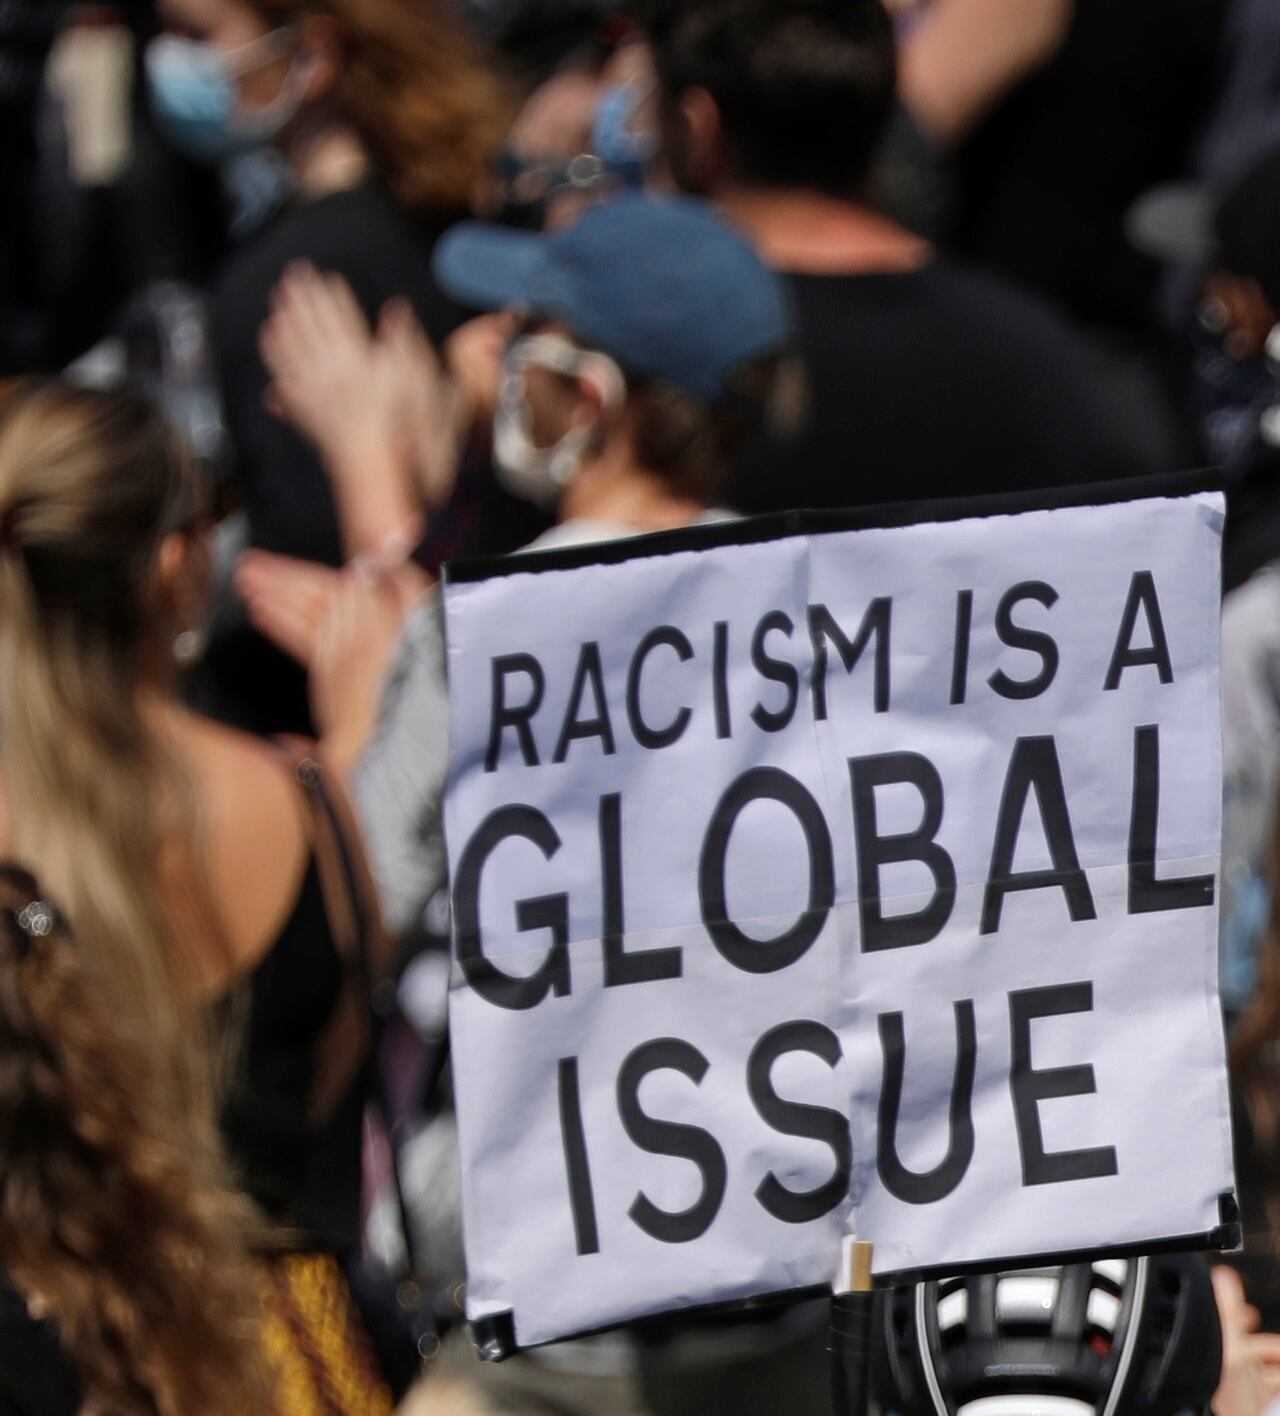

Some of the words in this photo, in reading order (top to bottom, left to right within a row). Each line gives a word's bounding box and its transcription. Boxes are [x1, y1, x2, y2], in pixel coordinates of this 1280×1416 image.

[482, 597, 892, 772] RACISM
[950, 581, 1059, 705] IS
[1105, 571, 1174, 690] A
[452, 725, 1215, 1010] GLOBAL
[558, 982, 1117, 1255] ISSUE
